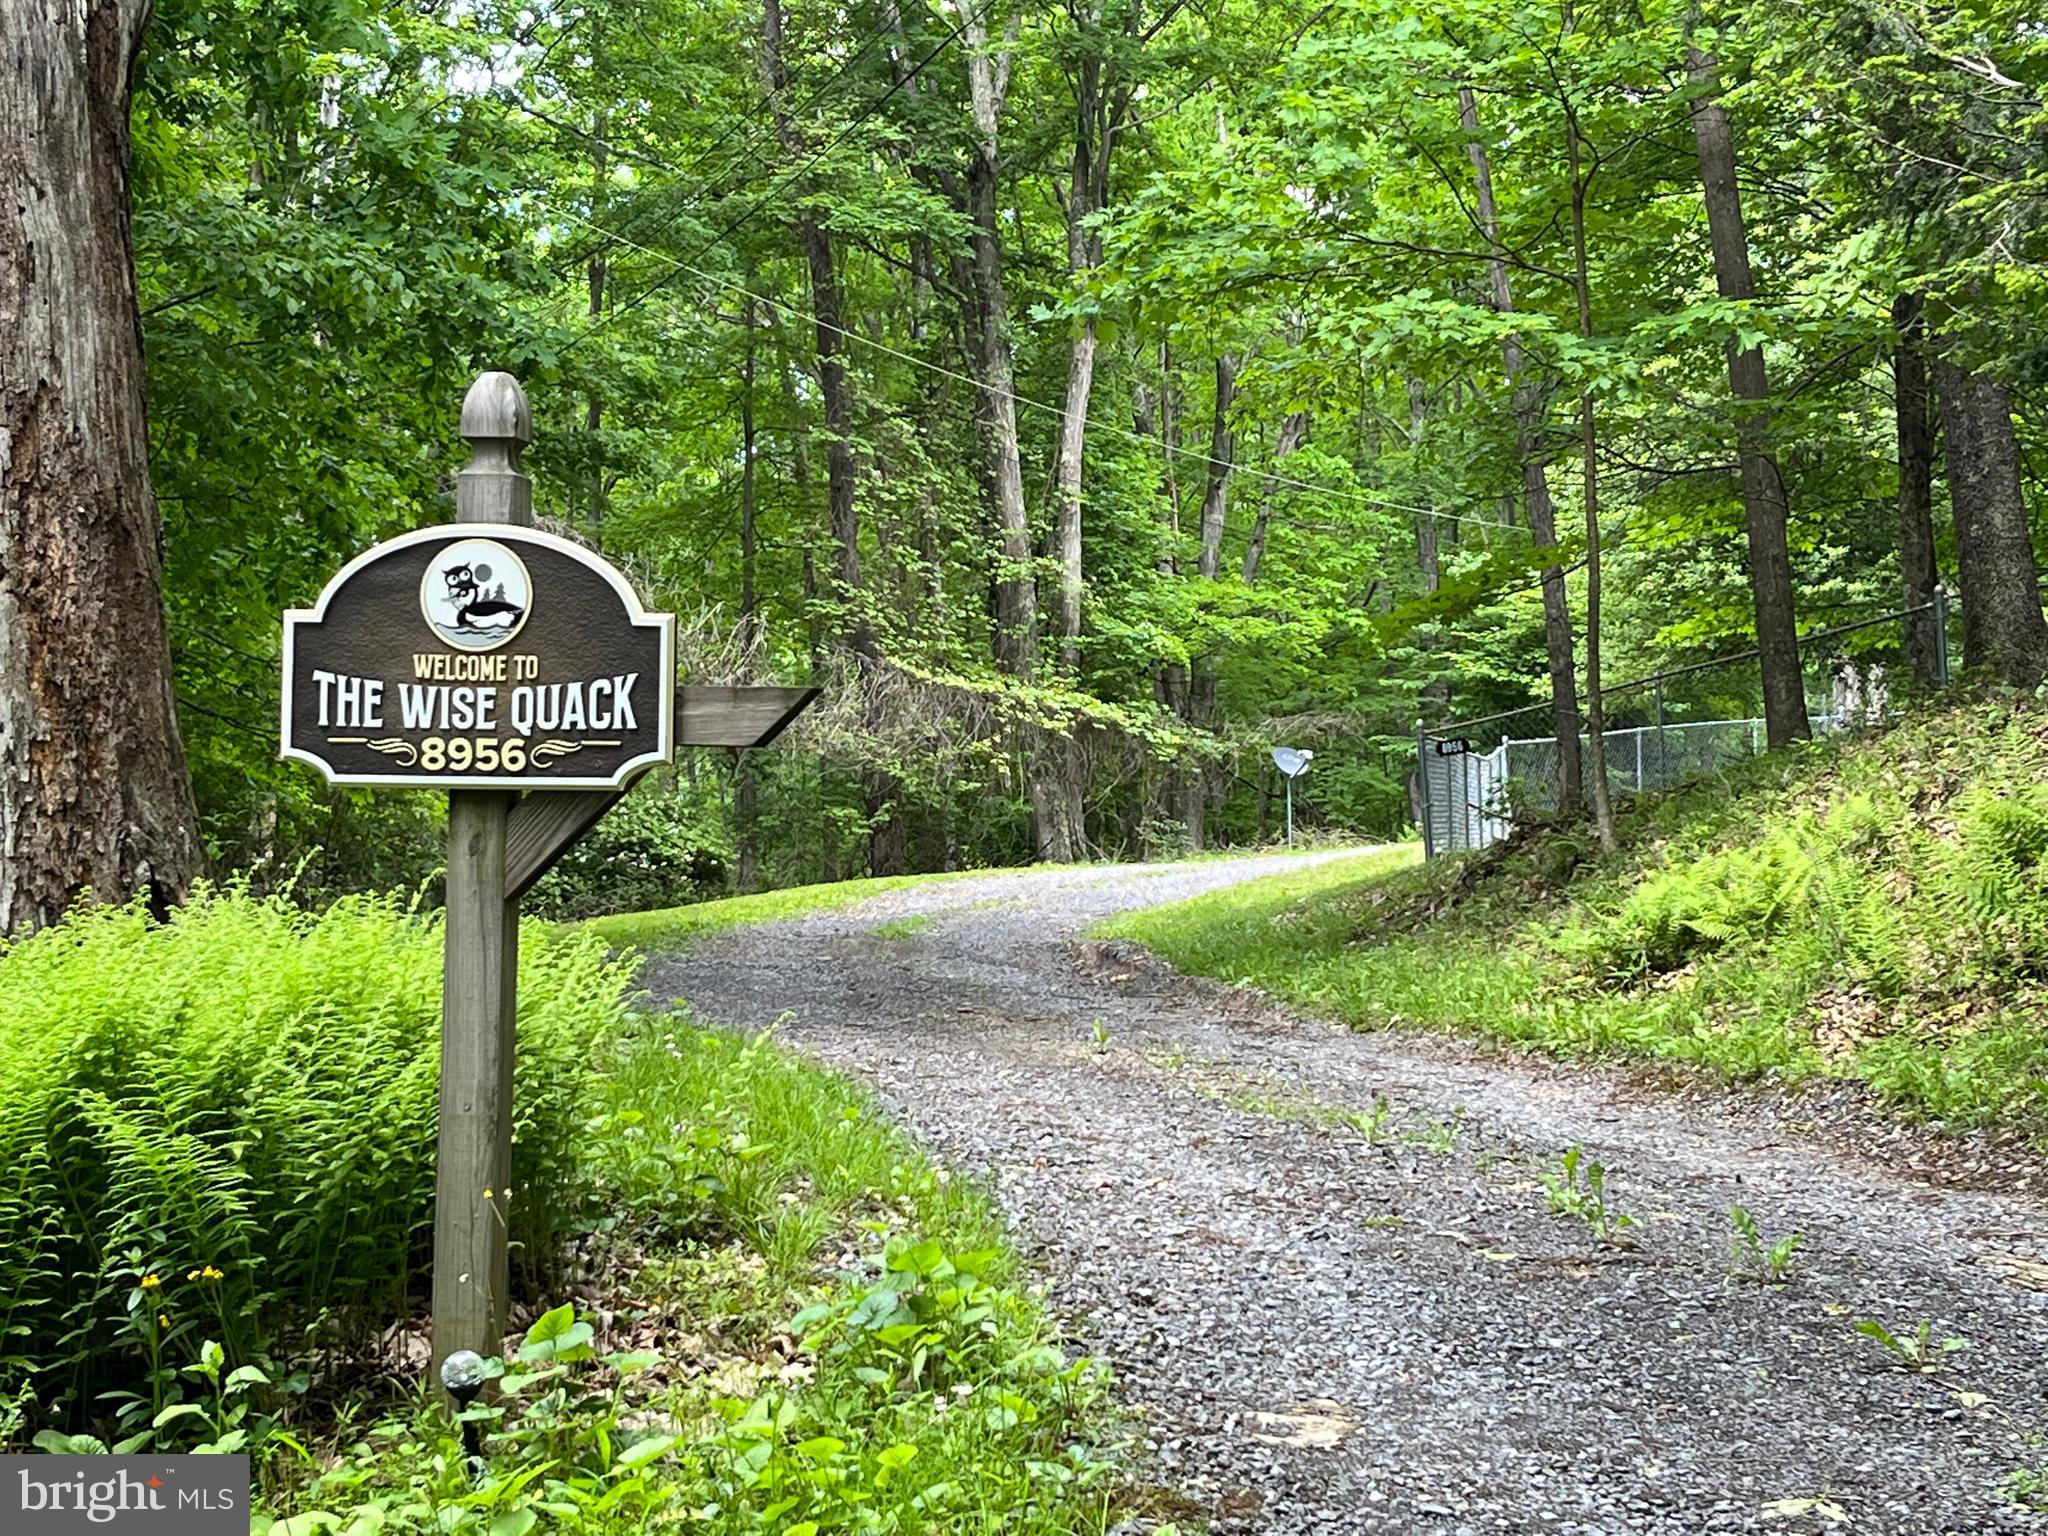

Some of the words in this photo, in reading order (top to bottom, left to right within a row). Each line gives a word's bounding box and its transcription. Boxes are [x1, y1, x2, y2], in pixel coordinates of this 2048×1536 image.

[413, 654, 507, 681] WELCOME
[513, 655, 539, 680] TO
[312, 670, 384, 728] THE
[397, 683, 498, 731] WISE
[511, 672, 639, 737] QUACK
[420, 737, 527, 772] 8956
